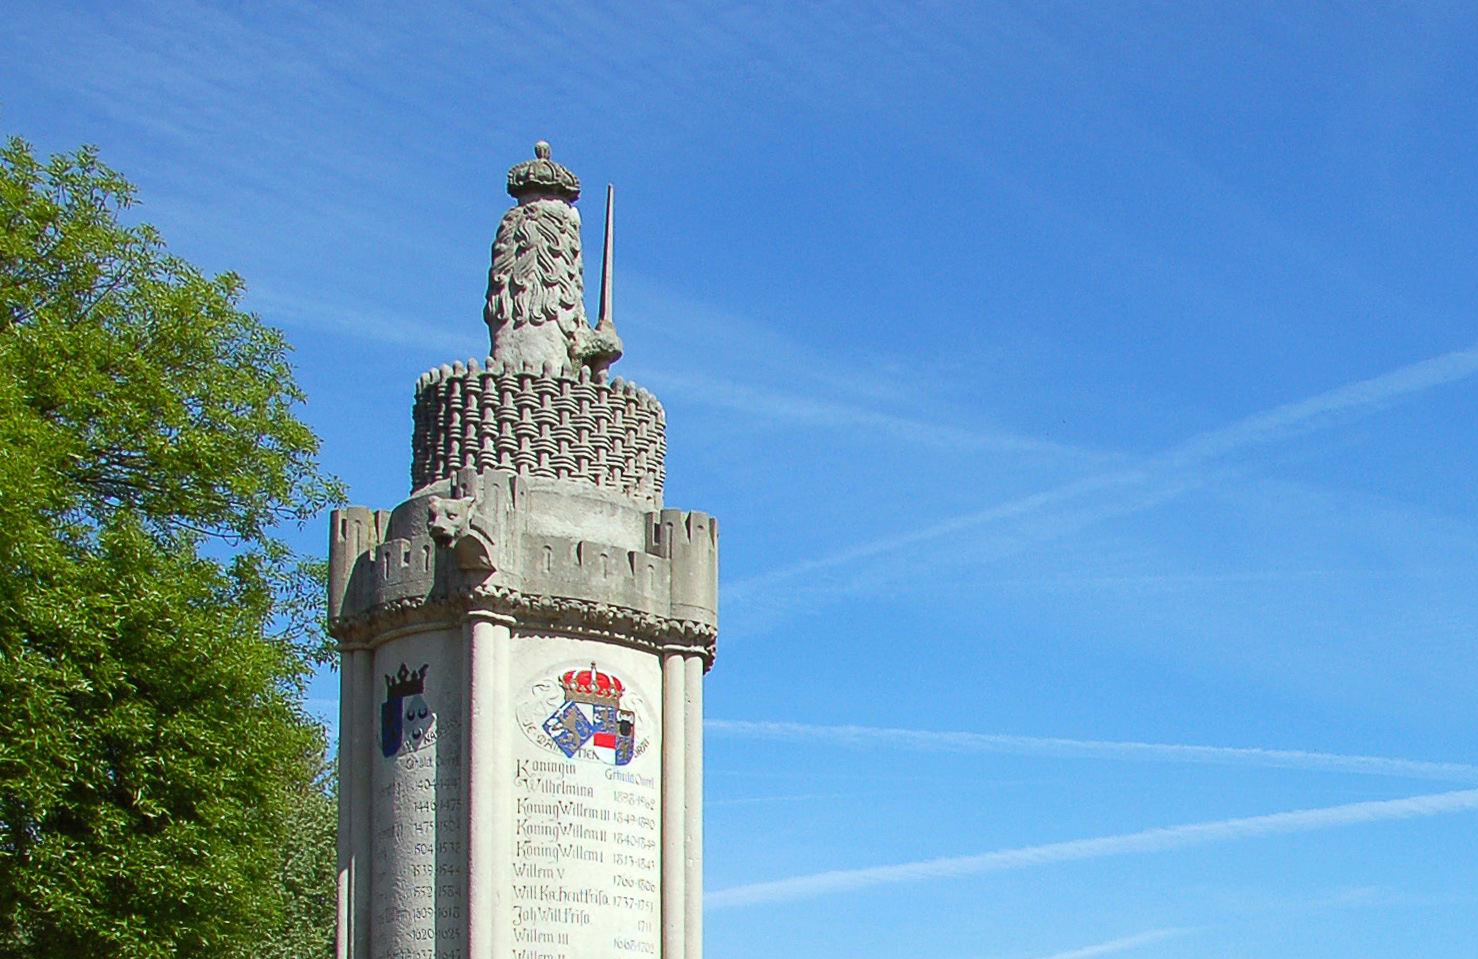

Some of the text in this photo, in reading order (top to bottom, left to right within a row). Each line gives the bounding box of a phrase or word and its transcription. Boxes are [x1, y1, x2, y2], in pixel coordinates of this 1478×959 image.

[516, 759, 577, 778] Koningin
[514, 778, 594, 798] Wilhelmina
[516, 797, 559, 821] Koning
[557, 800, 599, 819] Willem
[516, 819, 559, 842] Koning
[557, 821, 599, 841] Willem
[516, 840, 559, 863] Koning
[557, 843, 599, 862] Willem
[512, 863, 554, 879] Willem
[556, 867, 566, 879] V
[637, 920, 653, 932] 1711
[513, 927, 554, 944] Willem
[558, 932, 569, 946] III
